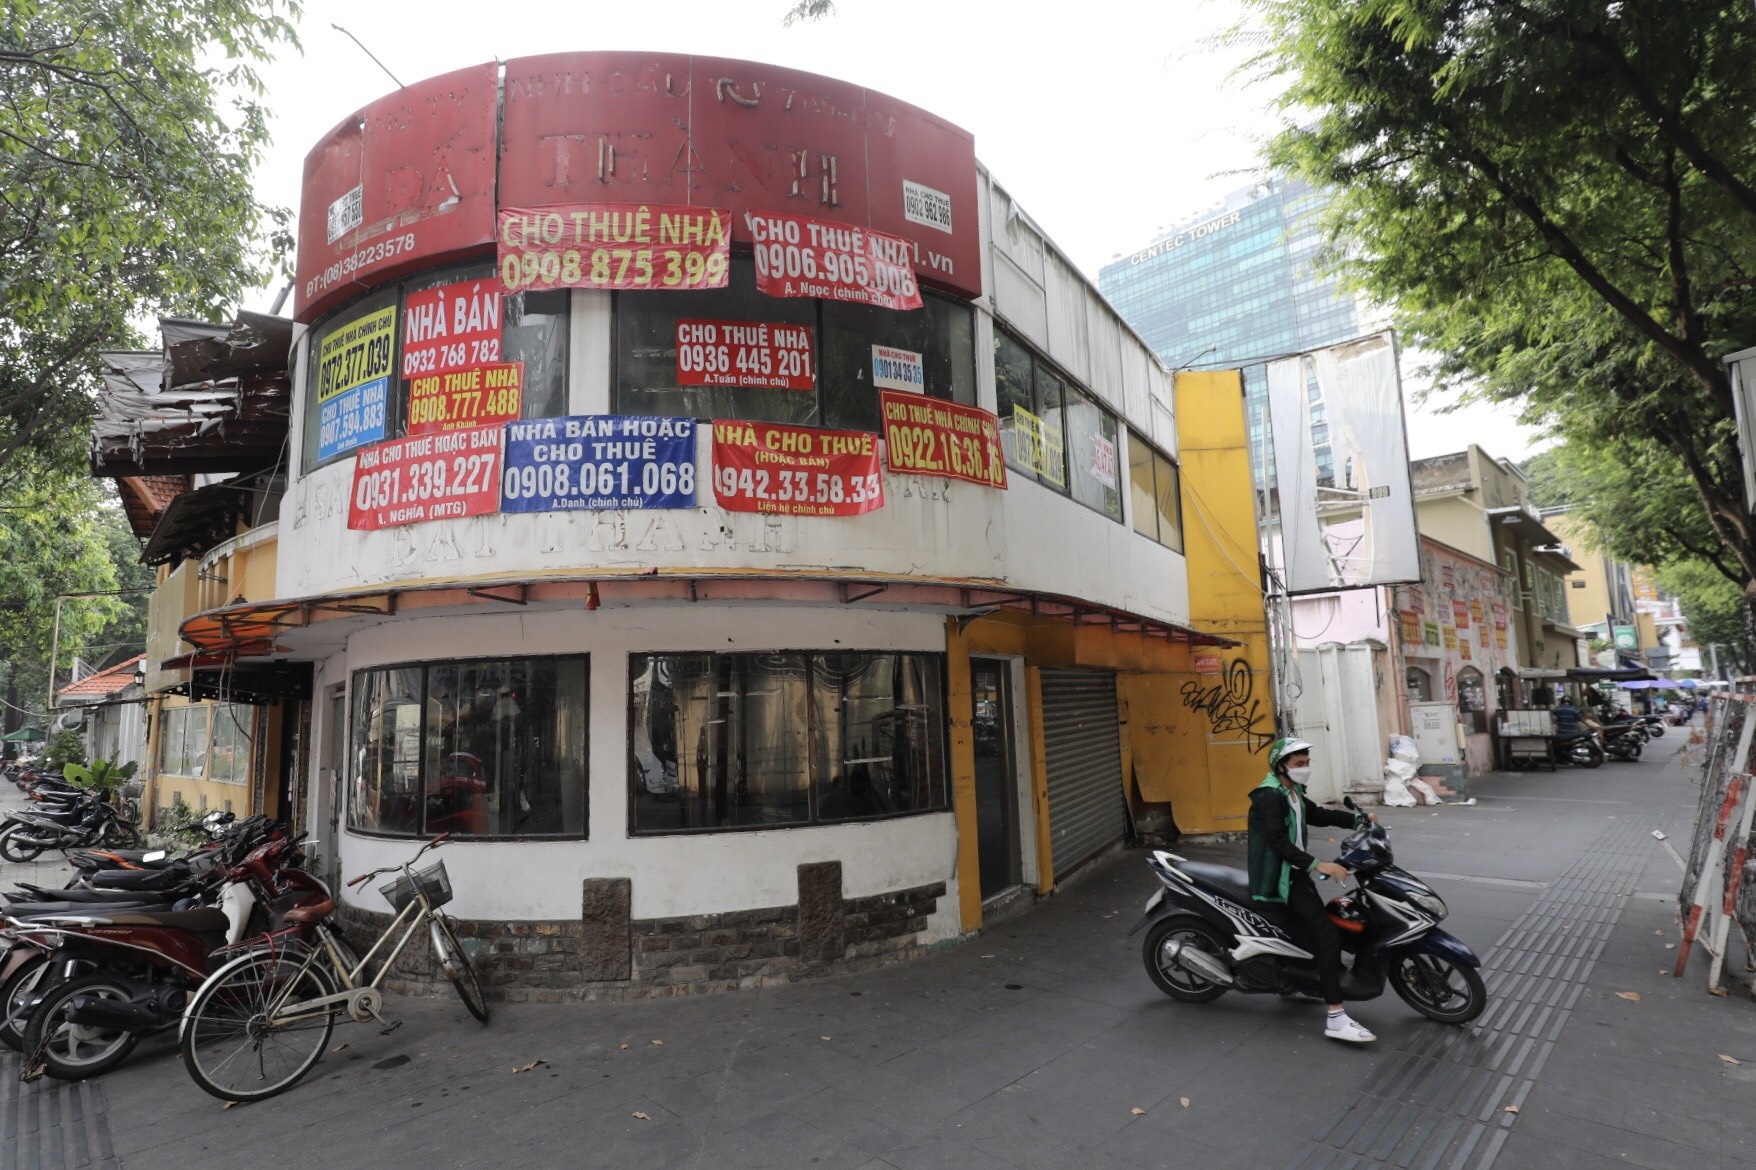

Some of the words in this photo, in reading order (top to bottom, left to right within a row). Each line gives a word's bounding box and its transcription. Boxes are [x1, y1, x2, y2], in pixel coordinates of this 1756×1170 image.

[502, 213, 565, 247] CHO
[570, 205, 652, 244] THUÊ
[659, 208, 725, 246] NHÀ
[906, 195, 924, 217] 0902
[924, 200, 938, 222] 962
[752, 216, 801, 244] CHO
[806, 227, 865, 254] THUÊ
[1130, 235, 1185, 265] CENTEC
[1190, 211, 1241, 241] TOWER
[502, 248, 582, 290] 0908
[590, 248, 654, 286] 875
[662, 250, 726, 286] 399
[755, 242, 916, 298] 0906.905.006
[784, 281, 797, 294] A.
[800, 281, 830, 298] Ngọc
[406, 289, 447, 344] NHÀ
[453, 282, 500, 335] BÁN
[678, 323, 717, 344] CHO
[721, 323, 768, 347] THUÊ
[773, 326, 809, 350] NHÀ
[320, 333, 390, 399] 0972.377.039
[403, 347, 436, 375] 0932
[439, 342, 466, 368] 768
[471, 338, 499, 364] 782
[680, 344, 730, 373] 0936
[736, 347, 772, 375] 445
[777, 349, 810, 377] 201
[413, 376, 440, 398] CHO
[444, 367, 481, 393] THUÊ
[485, 363, 519, 388] NHÀ
[704, 373, 736, 384] A.Tuấn
[740, 374, 768, 387] (chính
[322, 402, 337, 424] CHO
[339, 388, 360, 416] THUÊ
[362, 380, 384, 406] NHÀ
[411, 388, 519, 425] 0908.777.488
[886, 401, 907, 421] CHO
[908, 404, 934, 424] THUÊ
[934, 407, 953, 430] NHÀ
[954, 412, 981, 436] CHÍNH
[320, 401, 384, 449] 0907.594.883
[442, 421, 456, 431] Anh
[456, 419, 477, 429] Khánh
[511, 418, 556, 442] NHÀ
[565, 416, 613, 438] BÁN
[623, 416, 691, 441] HOẶC
[714, 422, 758, 448] NHÀ
[765, 429, 812, 454] CHO
[819, 432, 874, 456] THUÊ
[382, 444, 401, 464] CHO
[470, 428, 498, 449] BÁN
[534, 443, 583, 462] CHO
[592, 438, 657, 460] THUÊ
[356, 453, 495, 511] 0931.339.227
[504, 461, 695, 500] 0908.061.068
[714, 463, 880, 504] 0942.33.58.33
[429, 500, 467, 519] (MTG)
[552, 497, 585, 509] A.Danh
[588, 496, 618, 508] (chính
[621, 496, 643, 508] chủ)
[779, 502, 790, 513] hệ
[818, 504, 835, 515] chủ
